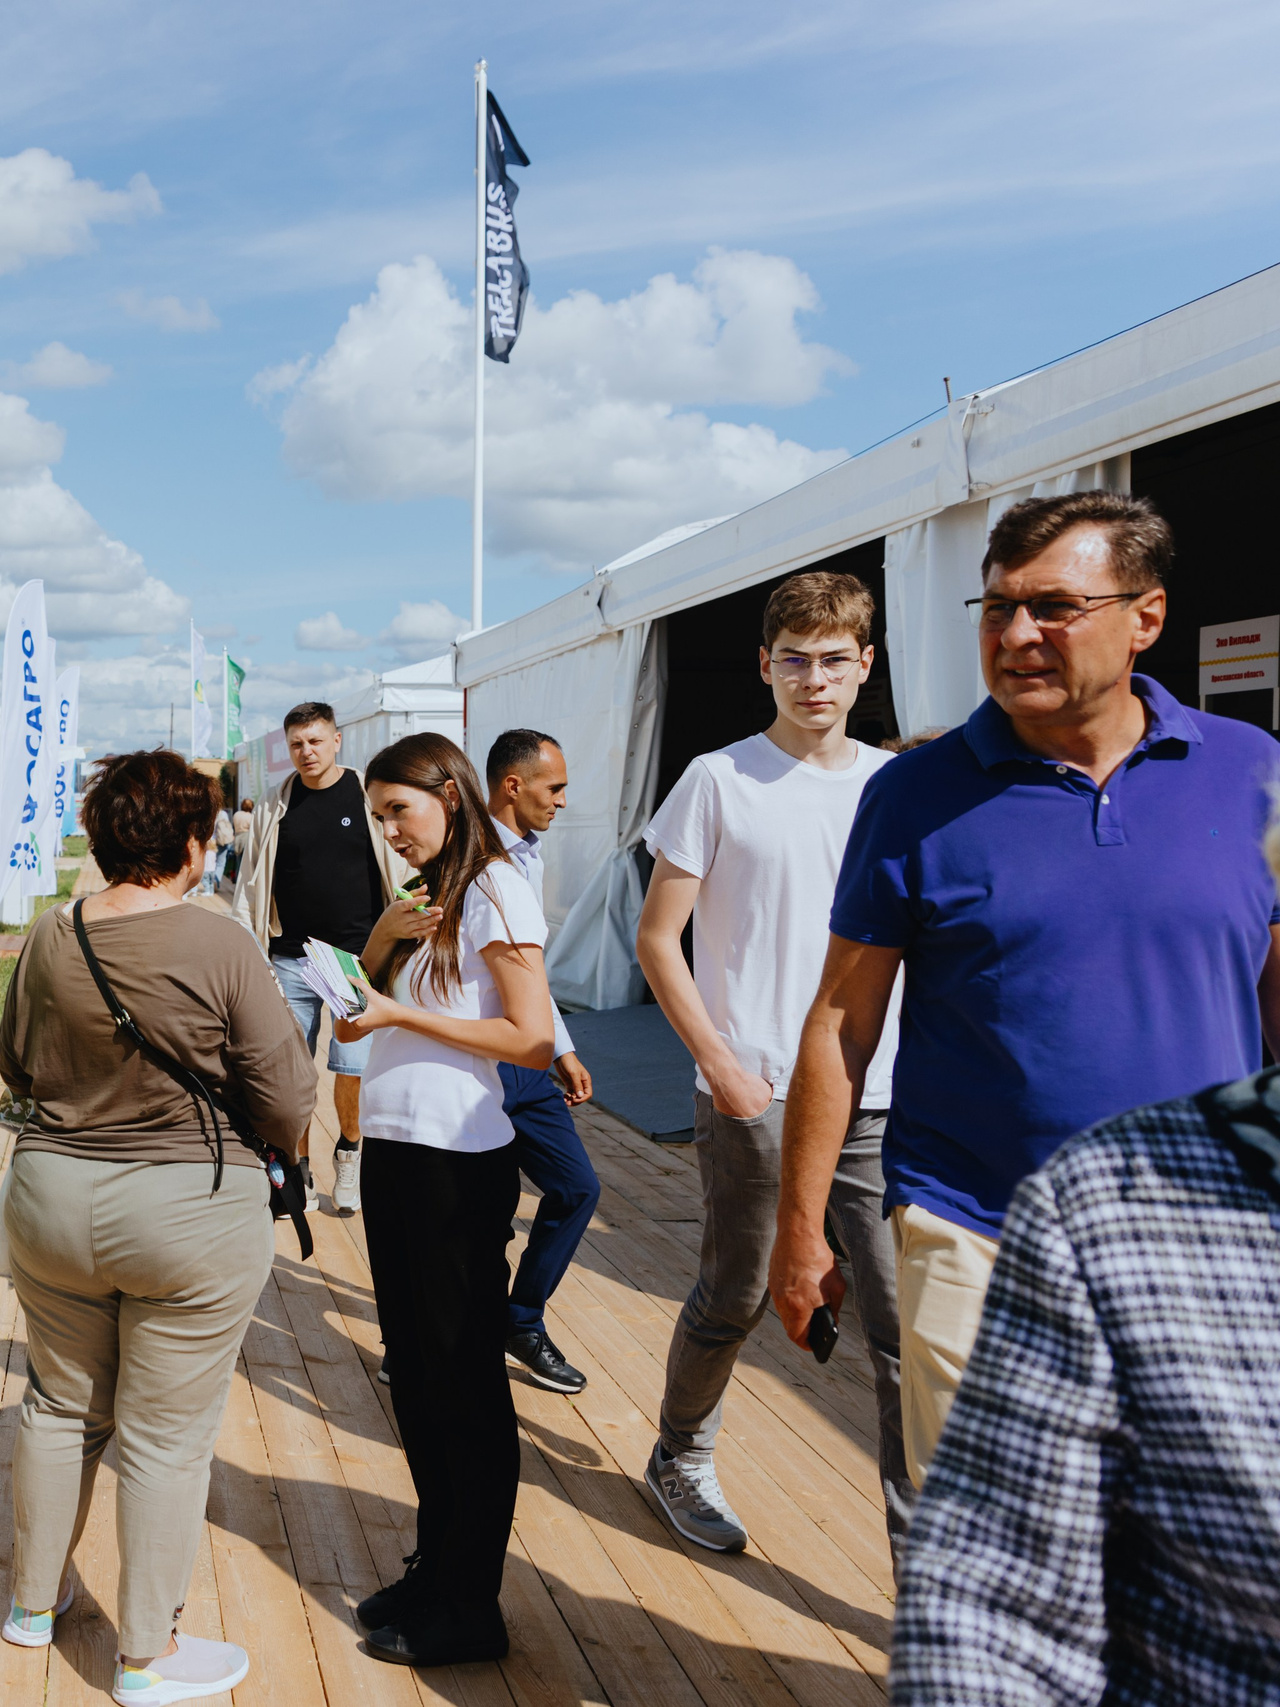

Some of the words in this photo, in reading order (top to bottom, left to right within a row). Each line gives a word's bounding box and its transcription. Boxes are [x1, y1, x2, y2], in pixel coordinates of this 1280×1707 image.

[1216, 638, 1228, 648] Эко
[1229, 634, 1261, 646] Вилладж
[1244, 671, 1265, 679] область
